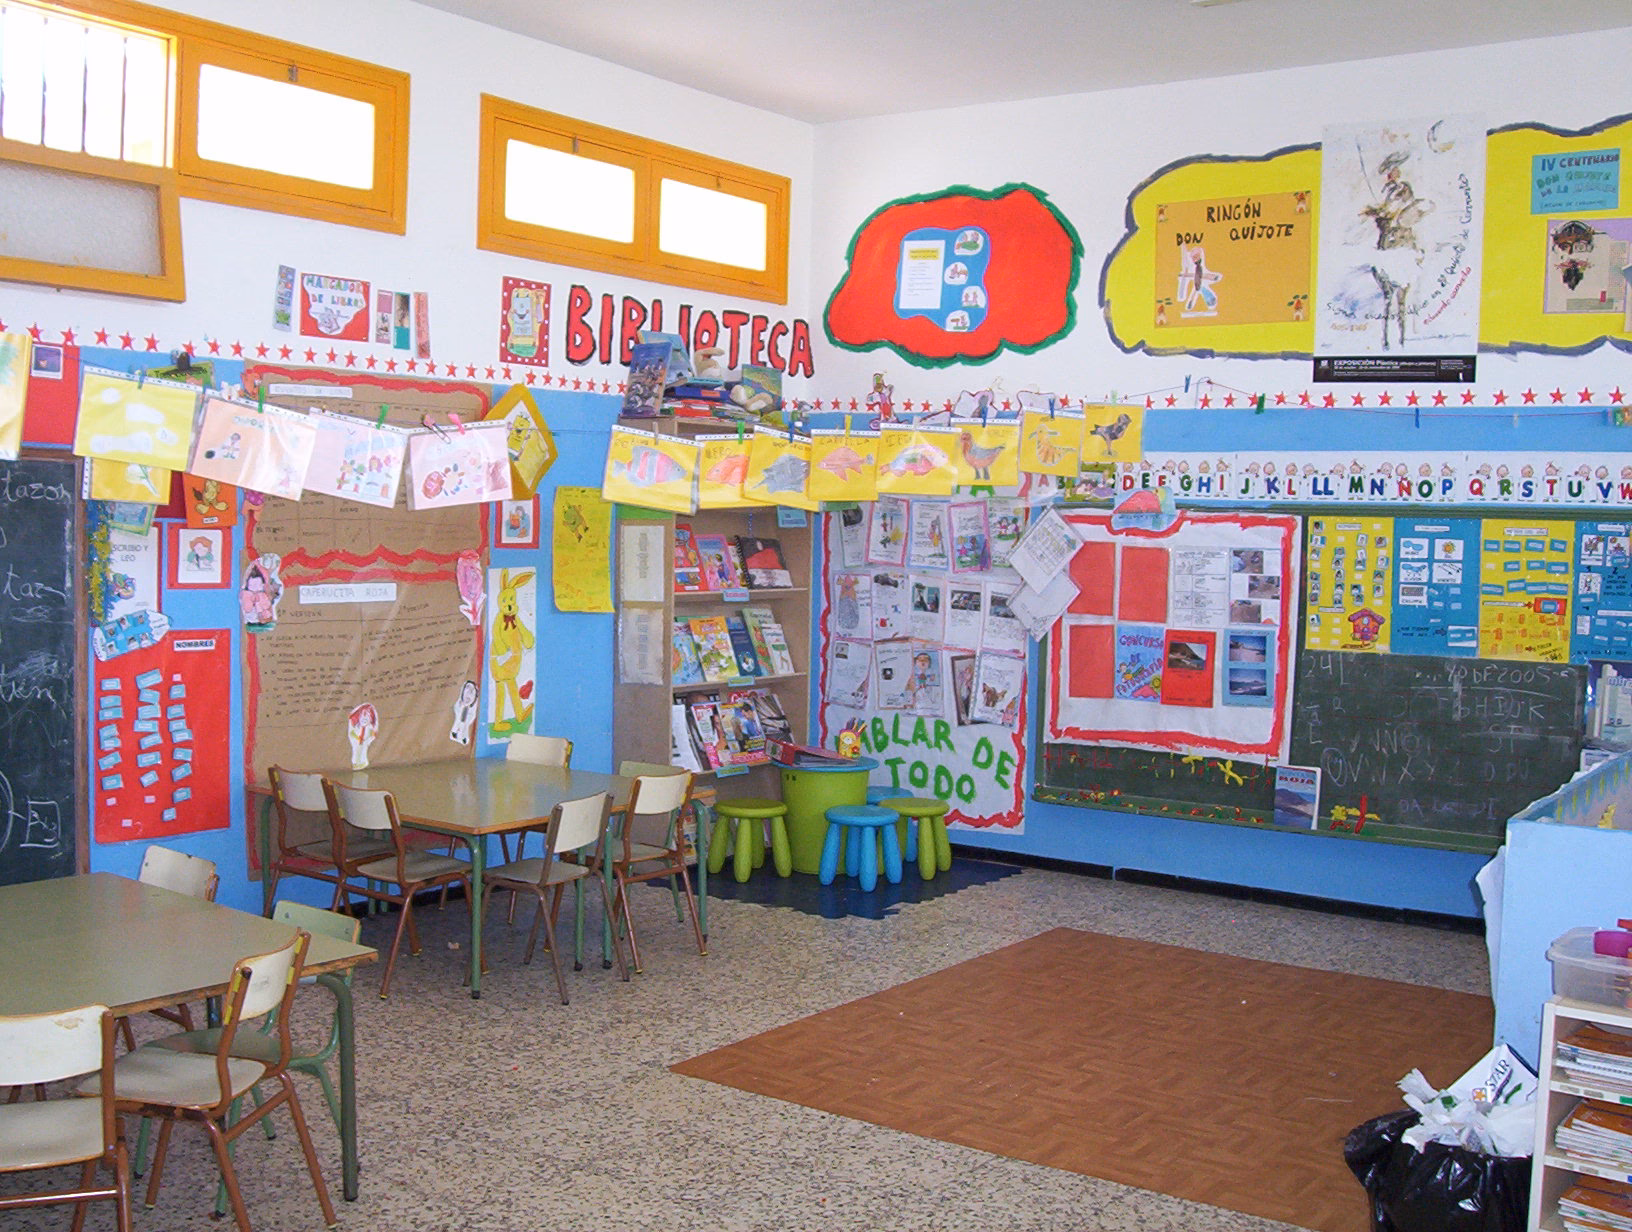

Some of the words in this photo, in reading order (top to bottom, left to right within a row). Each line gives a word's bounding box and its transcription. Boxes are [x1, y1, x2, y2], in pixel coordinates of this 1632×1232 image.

[1541, 158, 1556, 171] IV
[1176, 232, 1203, 246] DON
[1229, 222, 1294, 241] QUIJOTE
[1122, 476, 1135, 491] D
[1140, 473, 1151, 489] E
[1180, 475, 1192, 492] G
[1198, 476, 1211, 493] H
[1219, 475, 1225, 491] I
[1240, 477, 1250, 495] J
[1267, 477, 1281, 494] K
[1287, 479, 1296, 496] L
[1312, 477, 1334, 496] LL
[1350, 476, 1365, 494] M
[1370, 478, 1385, 496] N
[1397, 477, 1412, 497] Ñ
[1418, 479, 1433, 498] O
[1442, 478, 1453, 495] P
[1469, 479, 1484, 497] Q
[1500, 478, 1513, 496] R
[1522, 480, 1534, 498] S
[1546, 479, 1557, 496] T
[1568, 480, 1583, 498] U
[1597, 481, 1613, 498] V
[112, 544, 142, 552] SCRIBO
[175, 640, 214, 648] NOMBRES
[1497, 665, 1552, 685] 2005
[1529, 698, 1545, 720] K
[834, 712, 957, 754] ABLAR
[971, 735, 1017, 790] DE
[884, 756, 977, 804] TODO
